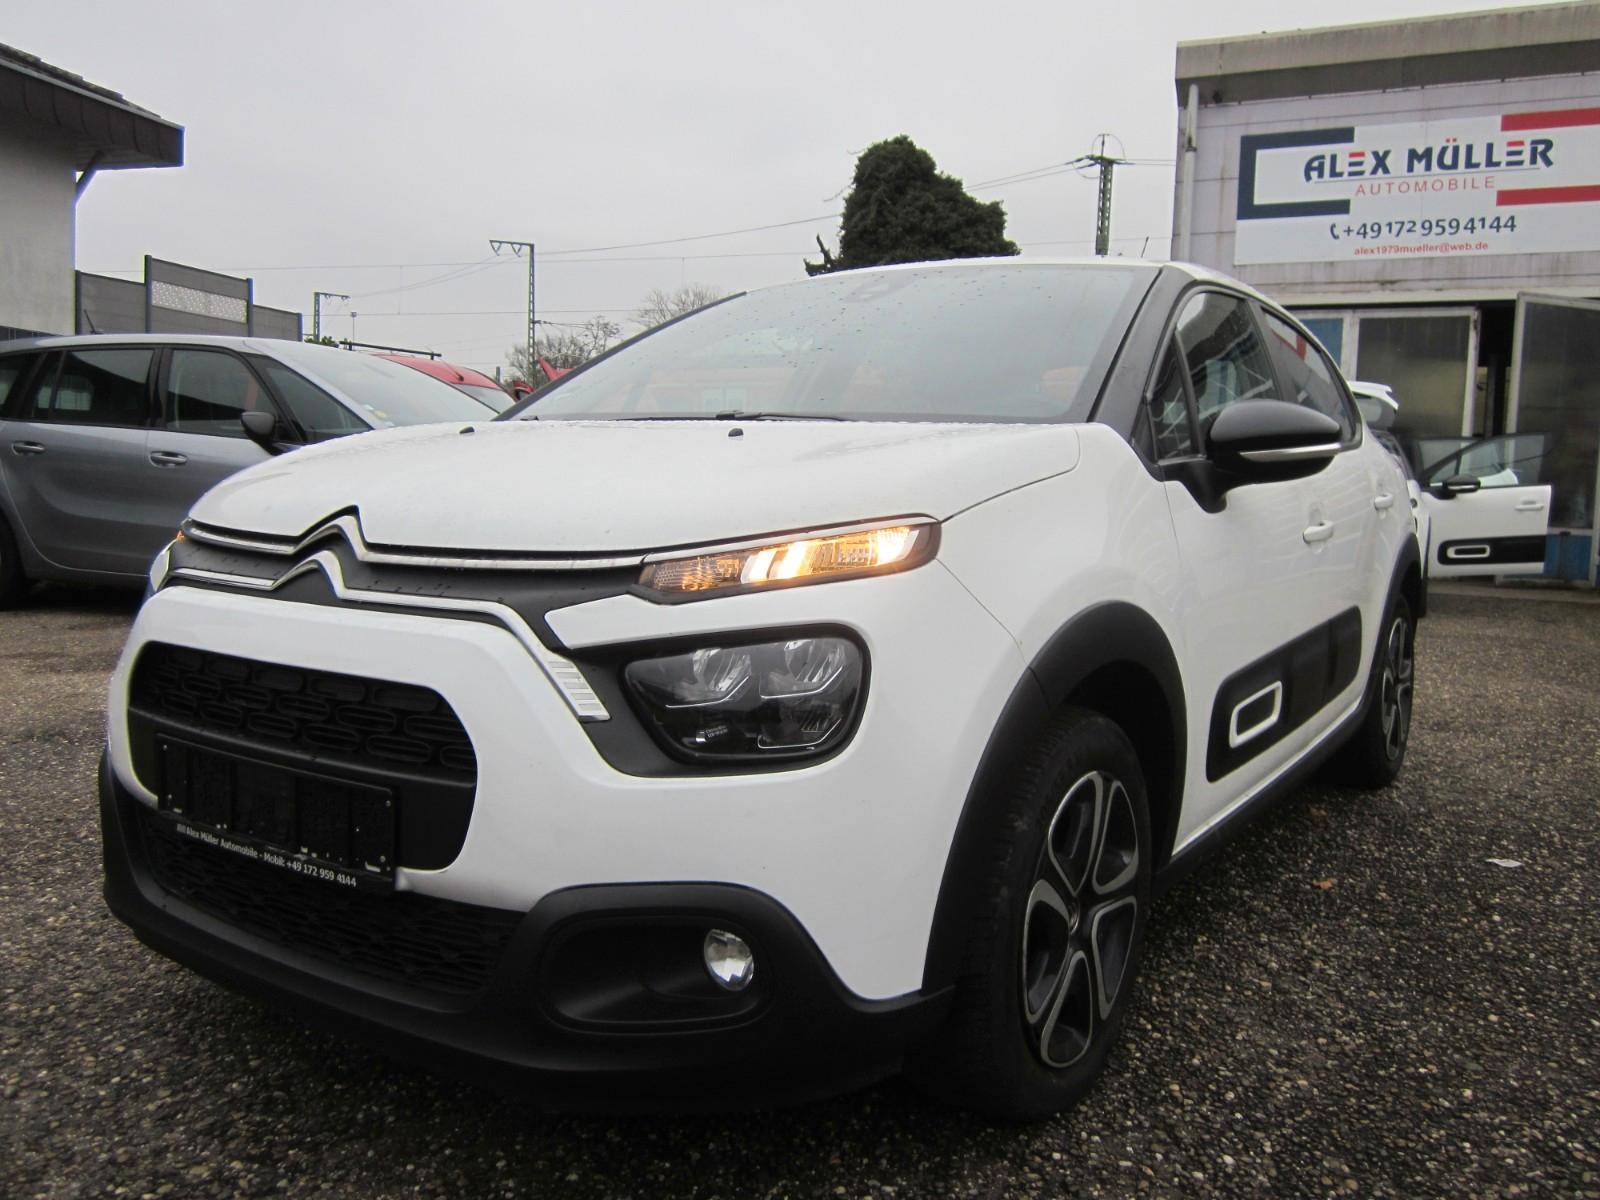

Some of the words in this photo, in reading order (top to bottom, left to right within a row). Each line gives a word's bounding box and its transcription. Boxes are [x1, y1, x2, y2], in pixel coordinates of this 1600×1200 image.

[1303, 150, 1392, 182] ALEX
[1406, 138, 1554, 174] MÜLLER
[1355, 177, 1496, 197] AUTOMOBILE
[1354, 242, 1489, 257] alex1979mueller@web.de
[186, 826, 199, 838] Alex
[220, 838, 258, 859] Automobile
[286, 860, 302, 872] +49
[303, 863, 318, 876] 172
[319, 867, 334, 881] 959
[336, 872, 357, 888] 4144
